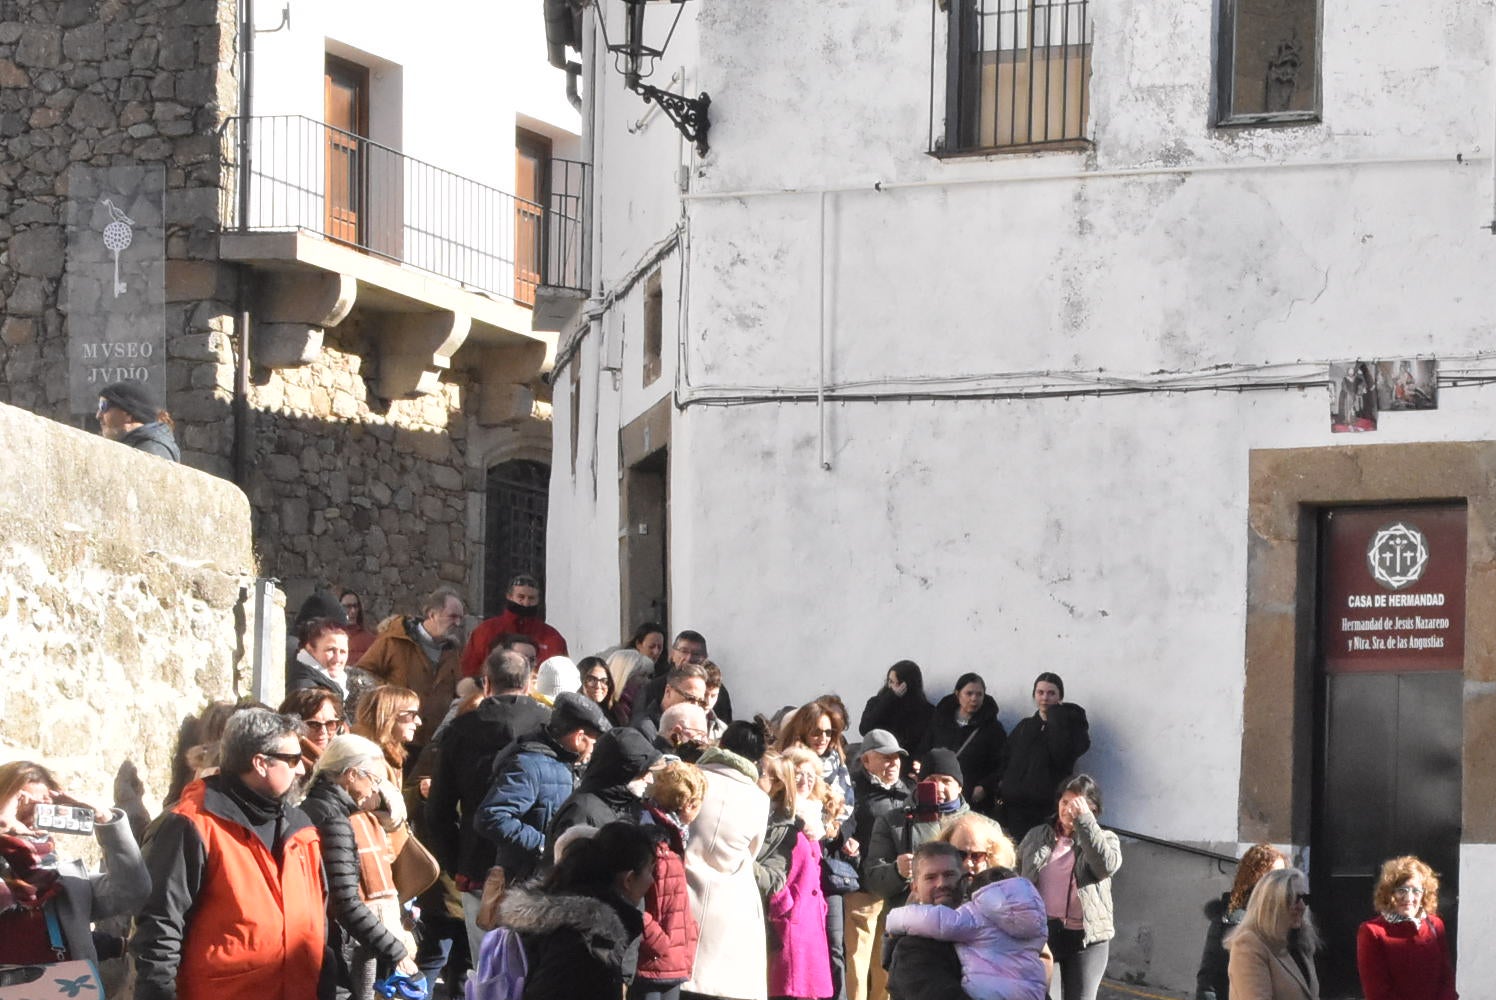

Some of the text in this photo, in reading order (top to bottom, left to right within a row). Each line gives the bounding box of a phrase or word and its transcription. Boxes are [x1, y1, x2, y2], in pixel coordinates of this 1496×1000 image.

[82, 342, 153, 358] MVSEO
[1348, 593, 1445, 608] CASA DE HERMANDAD
[1342, 617, 1383, 631] Hermandad
[1384, 617, 1393, 630] de
[1415, 615, 1449, 629] Nazareno
[1348, 634, 1444, 652] y Ntra. Sra. de las Angustias
